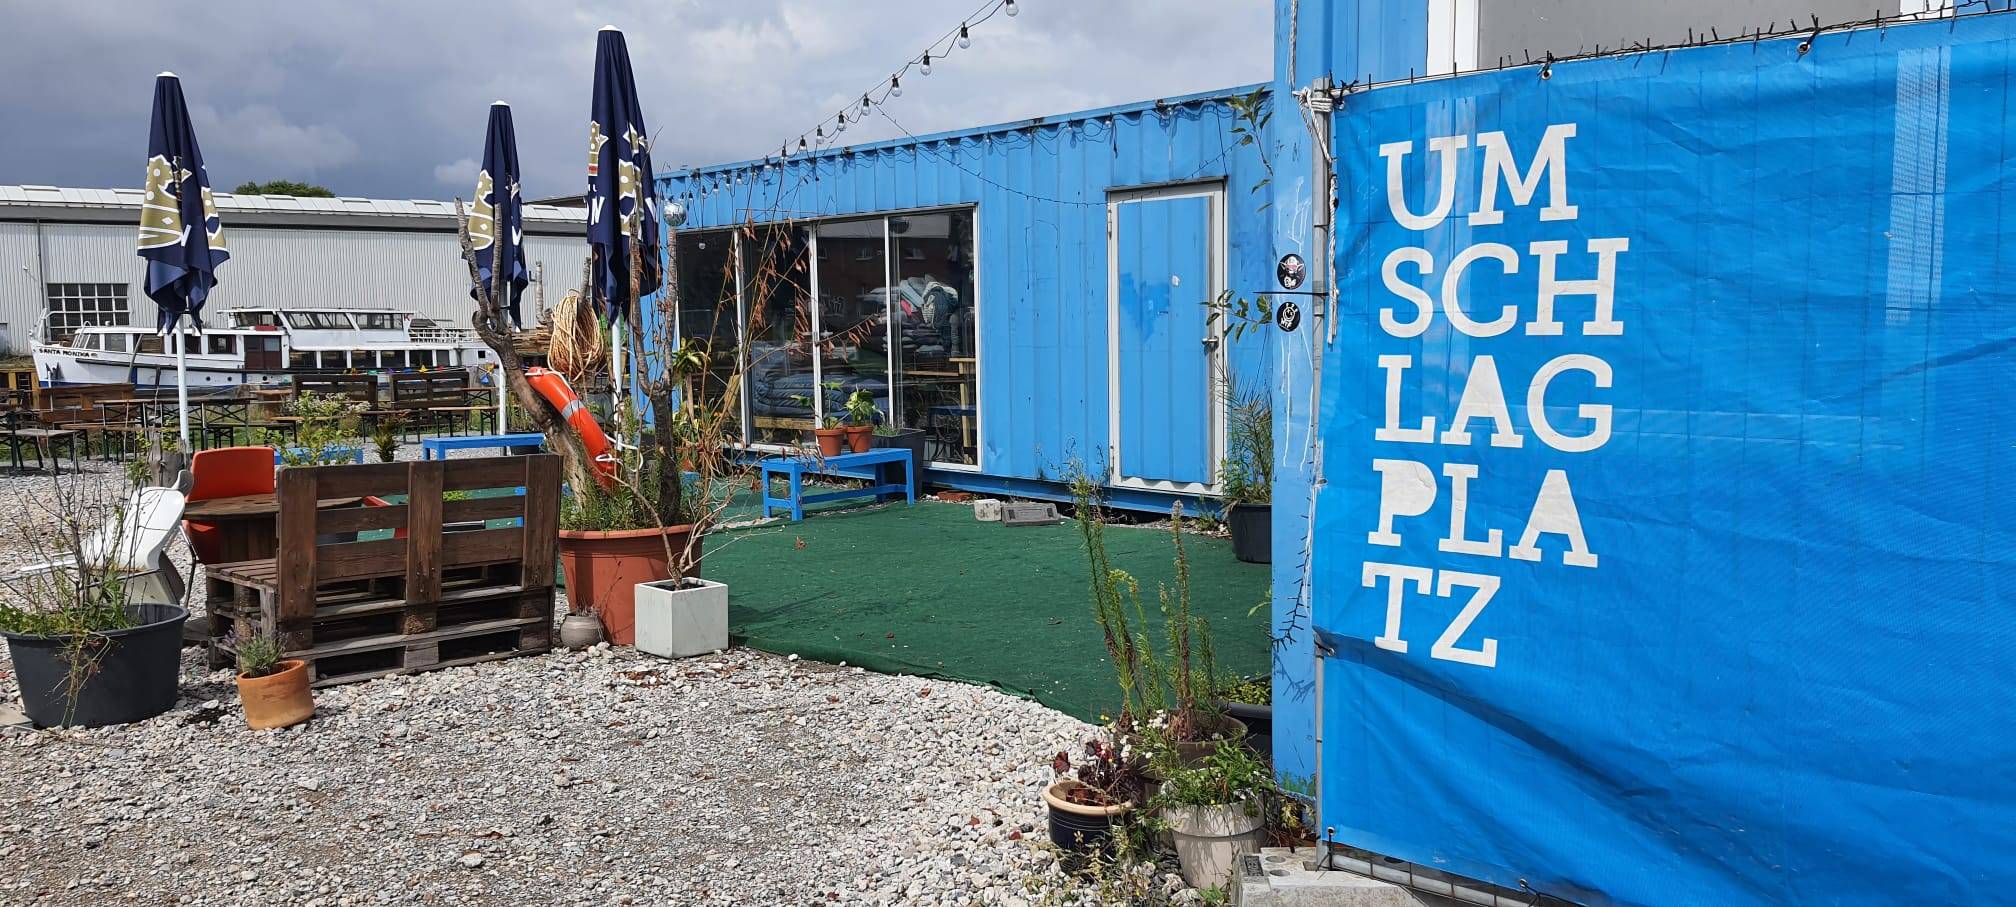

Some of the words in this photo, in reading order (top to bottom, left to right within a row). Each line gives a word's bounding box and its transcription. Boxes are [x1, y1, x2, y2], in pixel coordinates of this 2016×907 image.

[1379, 123, 1578, 231] UM
[1379, 237, 1629, 338] SCH
[1375, 354, 1613, 452] LAG
[1368, 458, 1598, 568] PLA
[1362, 561, 1503, 668] TZ
